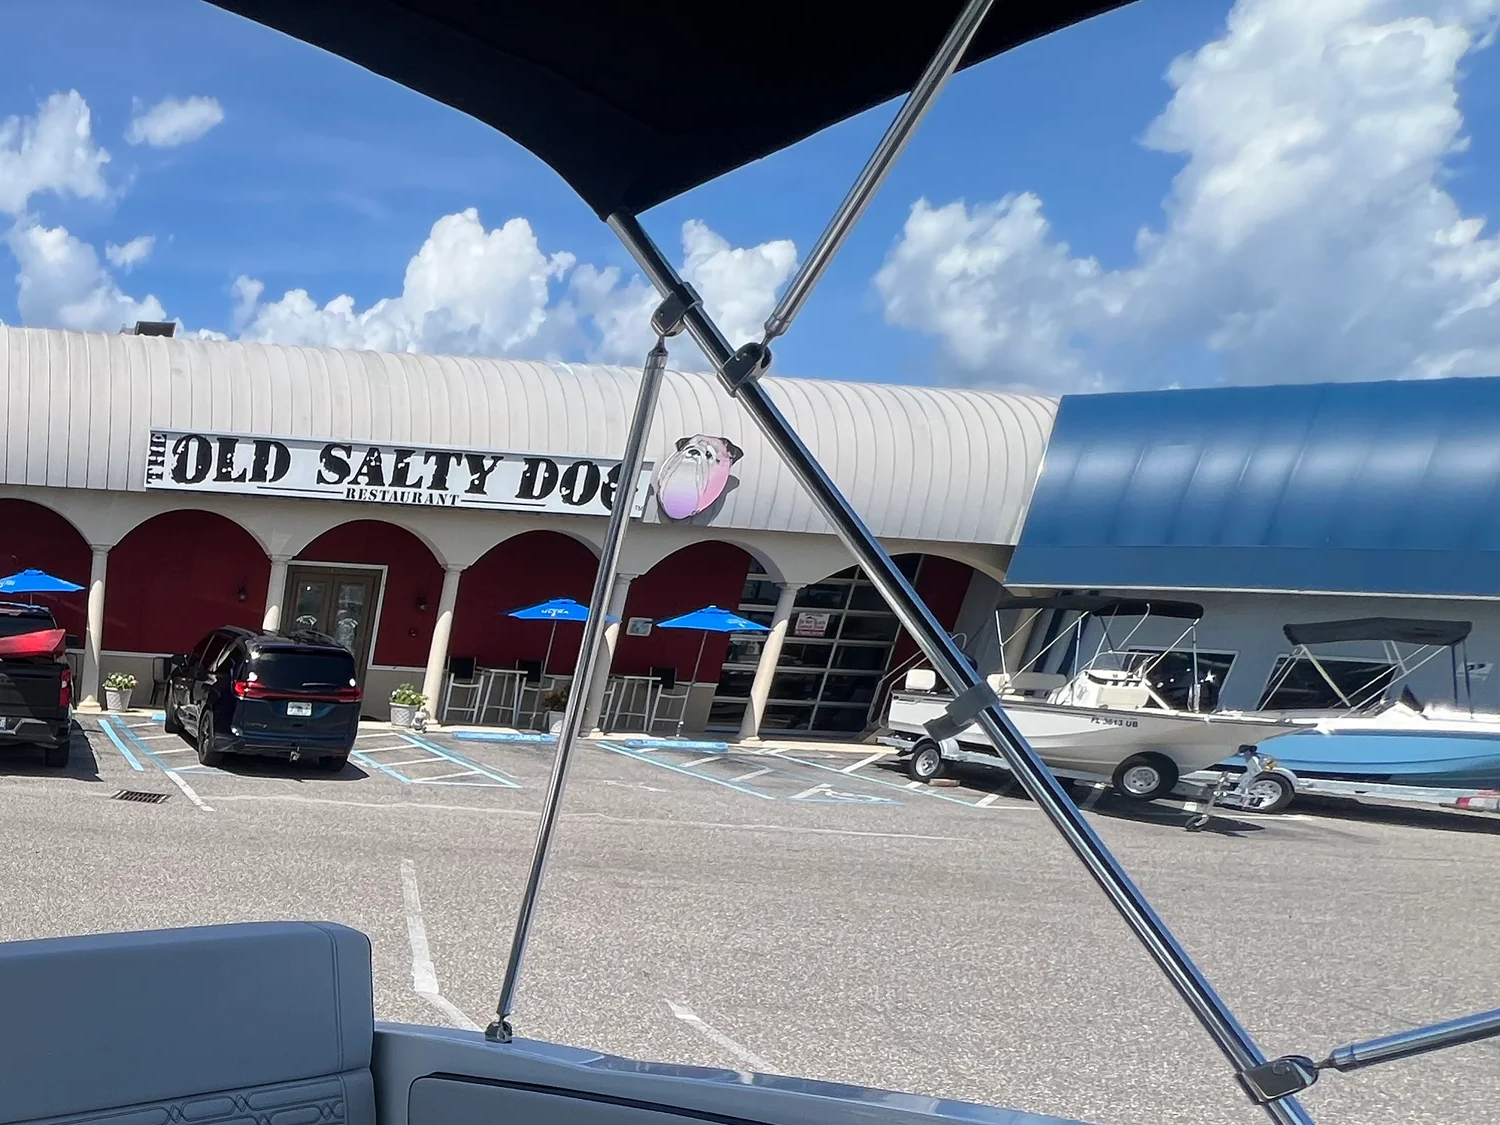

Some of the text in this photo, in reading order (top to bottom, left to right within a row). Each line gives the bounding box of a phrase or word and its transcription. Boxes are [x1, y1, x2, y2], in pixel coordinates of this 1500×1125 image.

[146, 433, 167, 484] THE
[170, 434, 292, 485] OLD
[316, 443, 504, 496] SALTY
[345, 487, 460, 506] RESTAURANT
